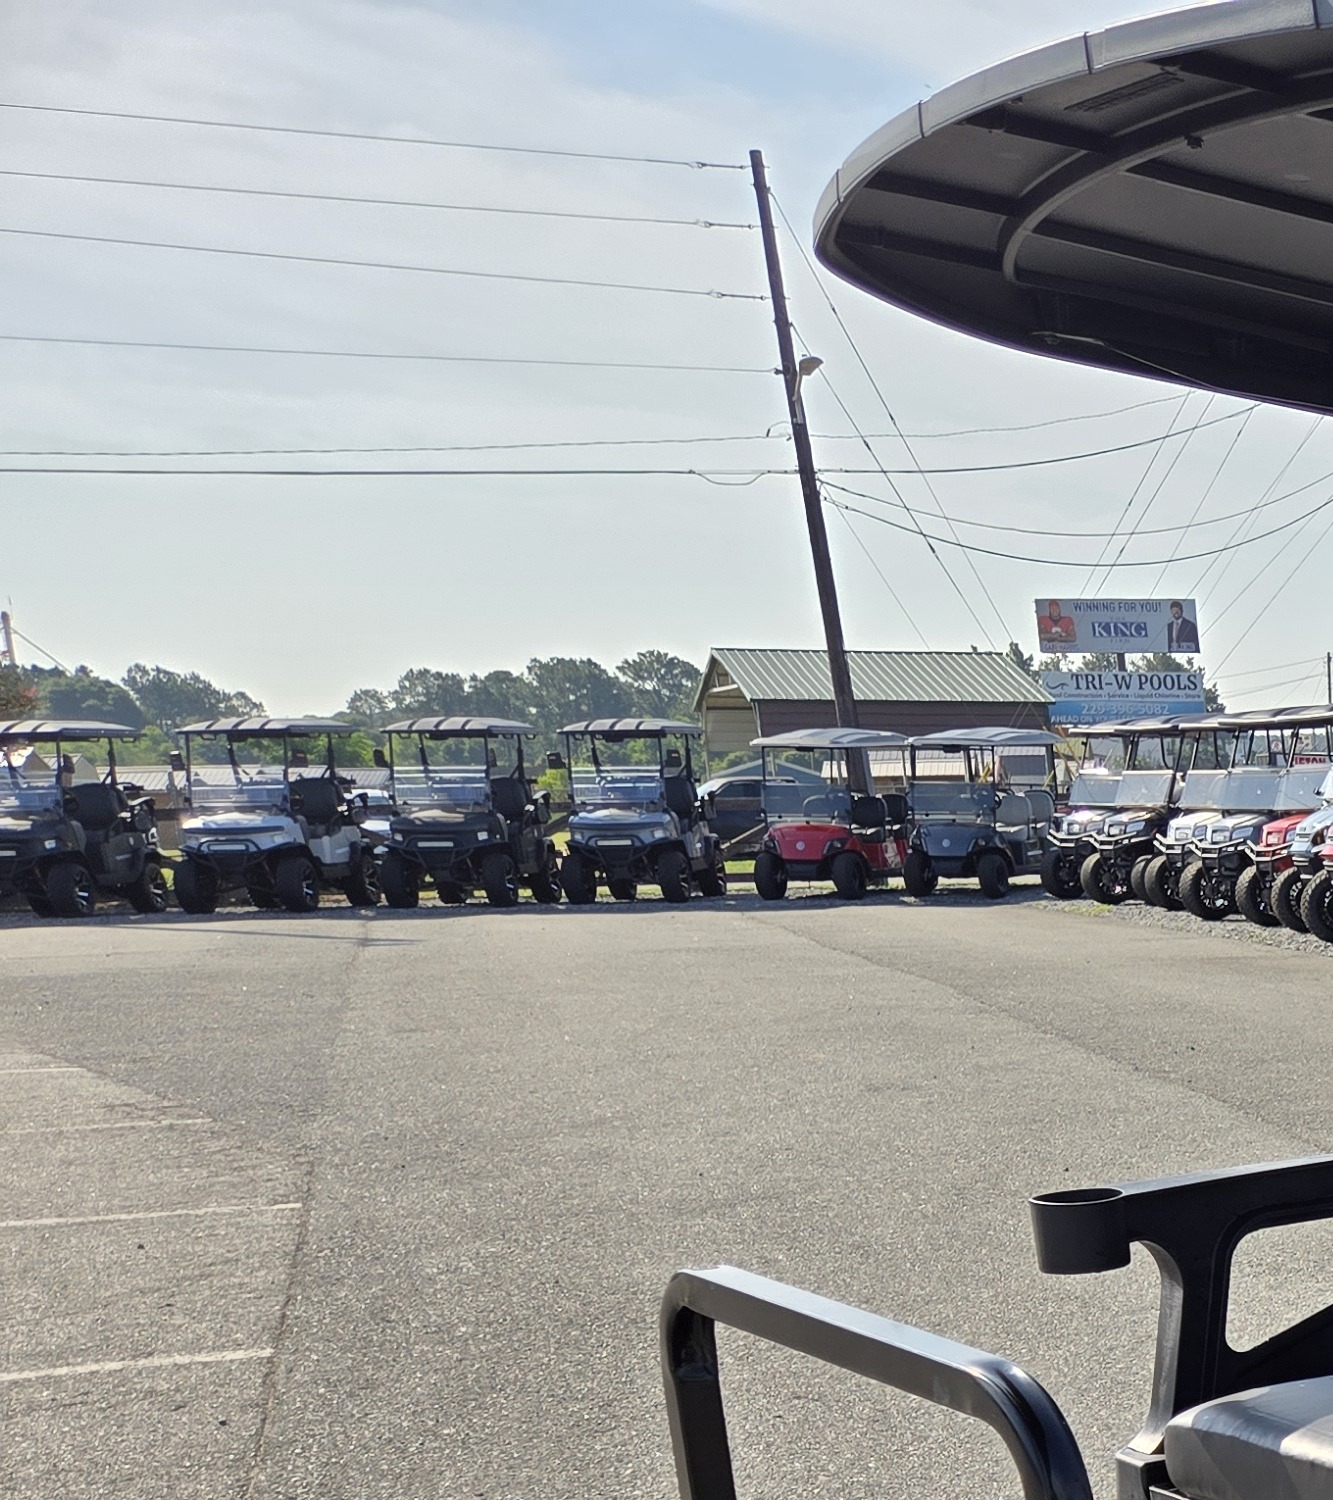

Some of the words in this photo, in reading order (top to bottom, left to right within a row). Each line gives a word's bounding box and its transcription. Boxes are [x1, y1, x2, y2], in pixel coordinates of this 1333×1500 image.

[1072, 601, 1116, 613] WINNING
[1118, 602, 1137, 613] FOR
[1139, 602, 1162, 613] YOU!
[1093, 622, 1147, 637] KING
[1070, 674, 1133, 691] TRI-W
[1138, 674, 1198, 691] POOLS
